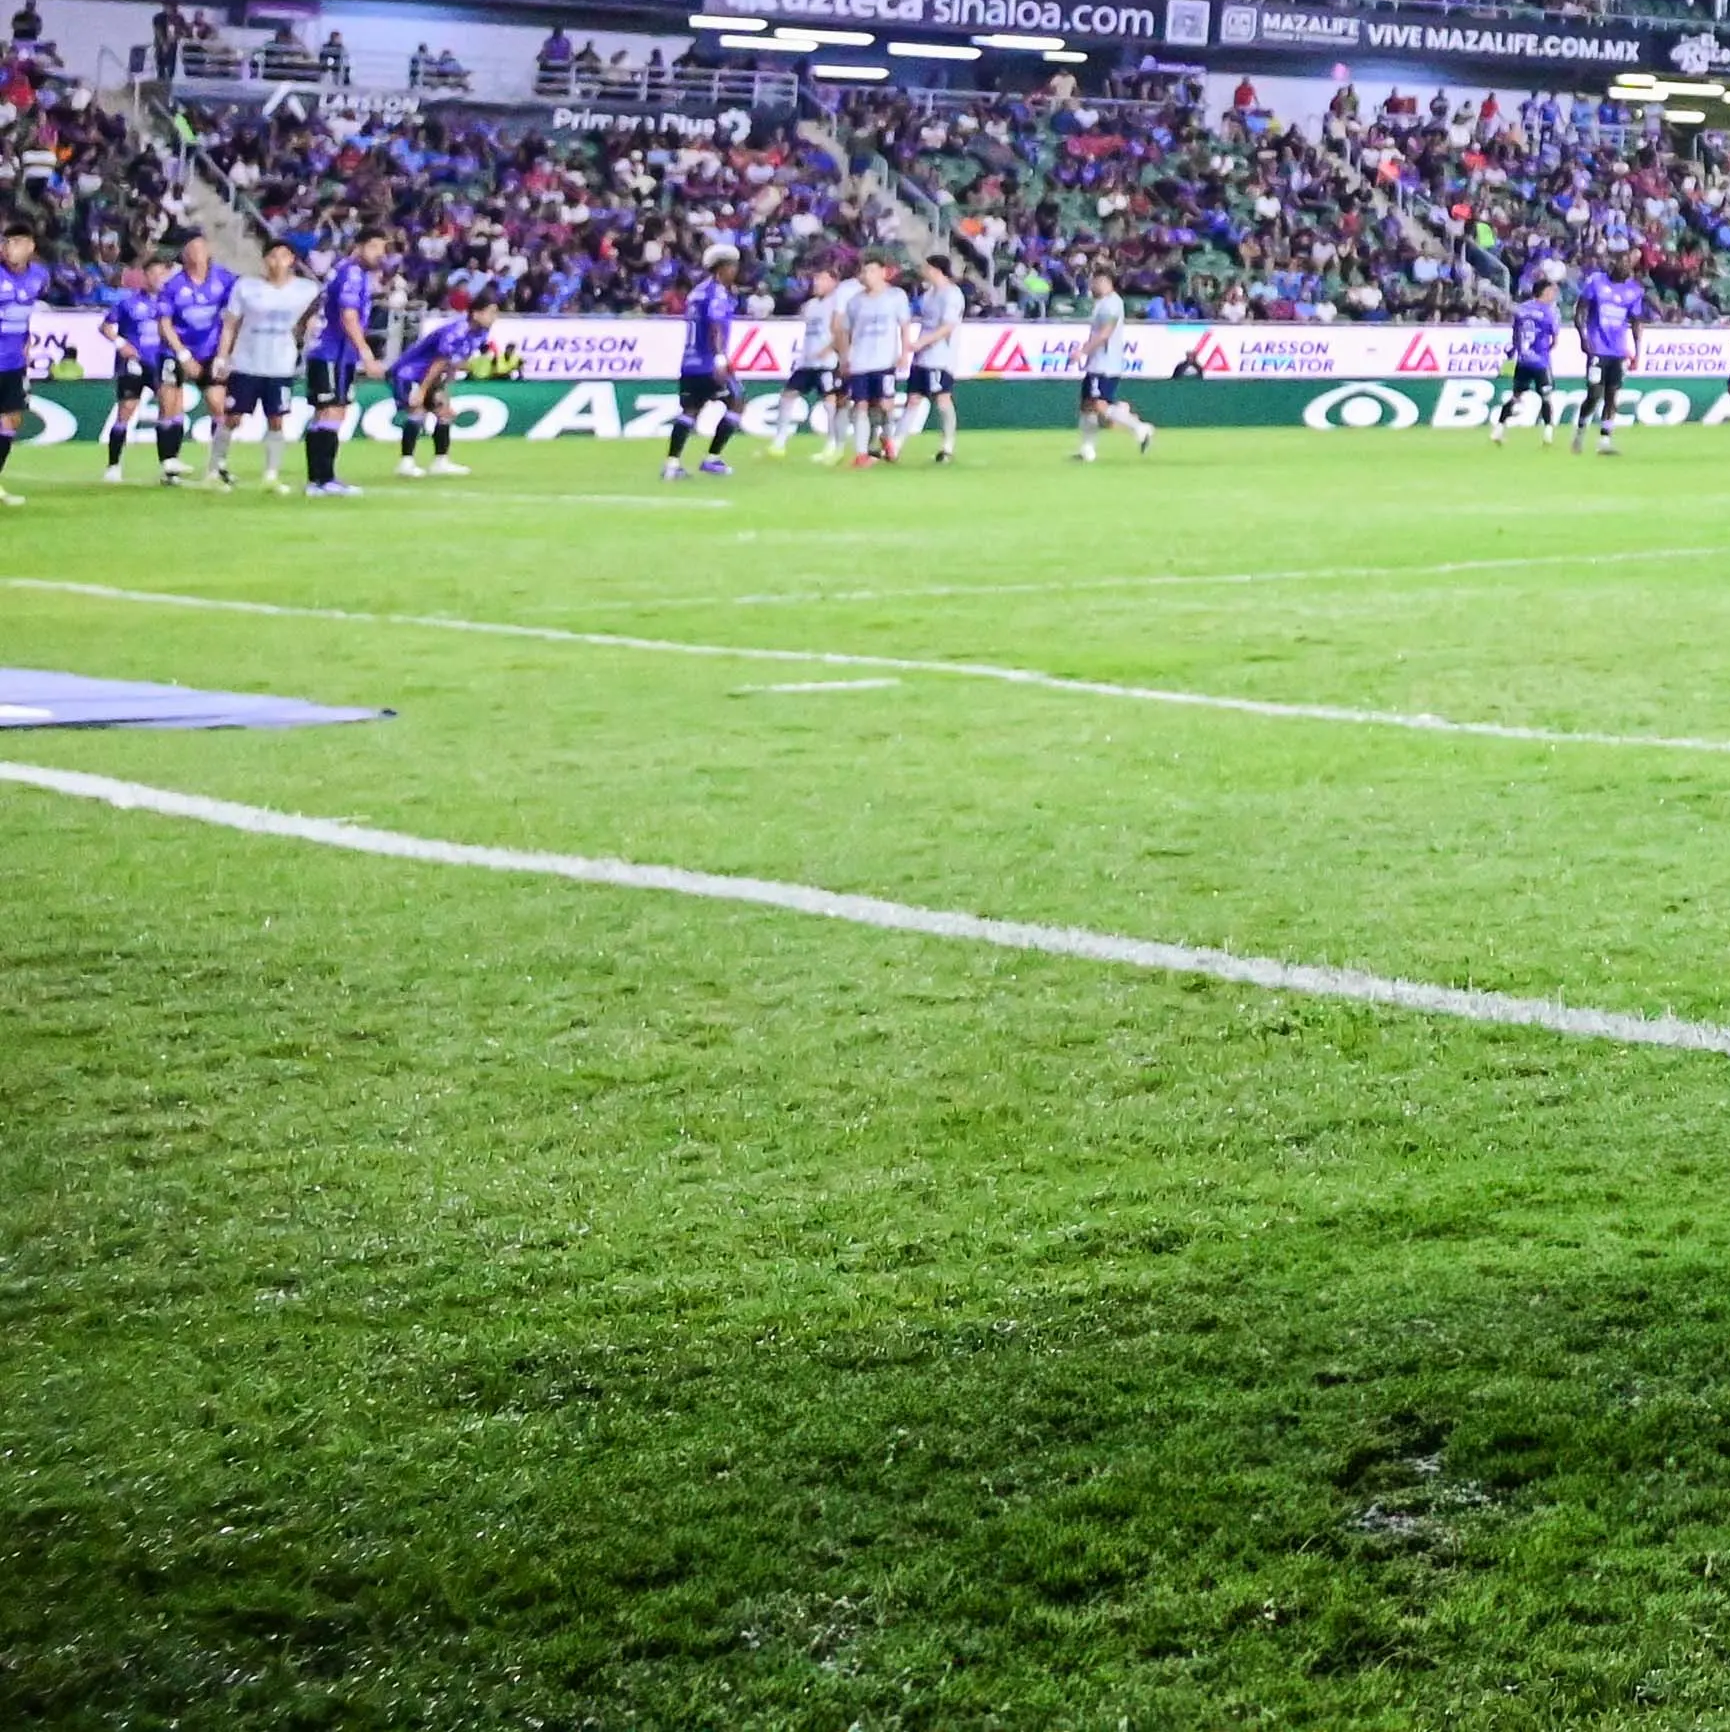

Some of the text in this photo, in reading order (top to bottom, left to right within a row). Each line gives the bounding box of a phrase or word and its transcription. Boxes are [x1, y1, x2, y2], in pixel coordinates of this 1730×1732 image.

[1263, 12, 1360, 36] MAZALIFE
[1369, 24, 1422, 48] VIVE
[1425, 26, 1640, 62] MAZALIFE.COM.MX
[521, 336, 638, 353] LARSSON
[1240, 340, 1329, 355] LARSSON
[1645, 341, 1723, 355] LARSSON
[1239, 358, 1334, 373] ELEVATOR
[1645, 358, 1726, 372] ELEVATOR
